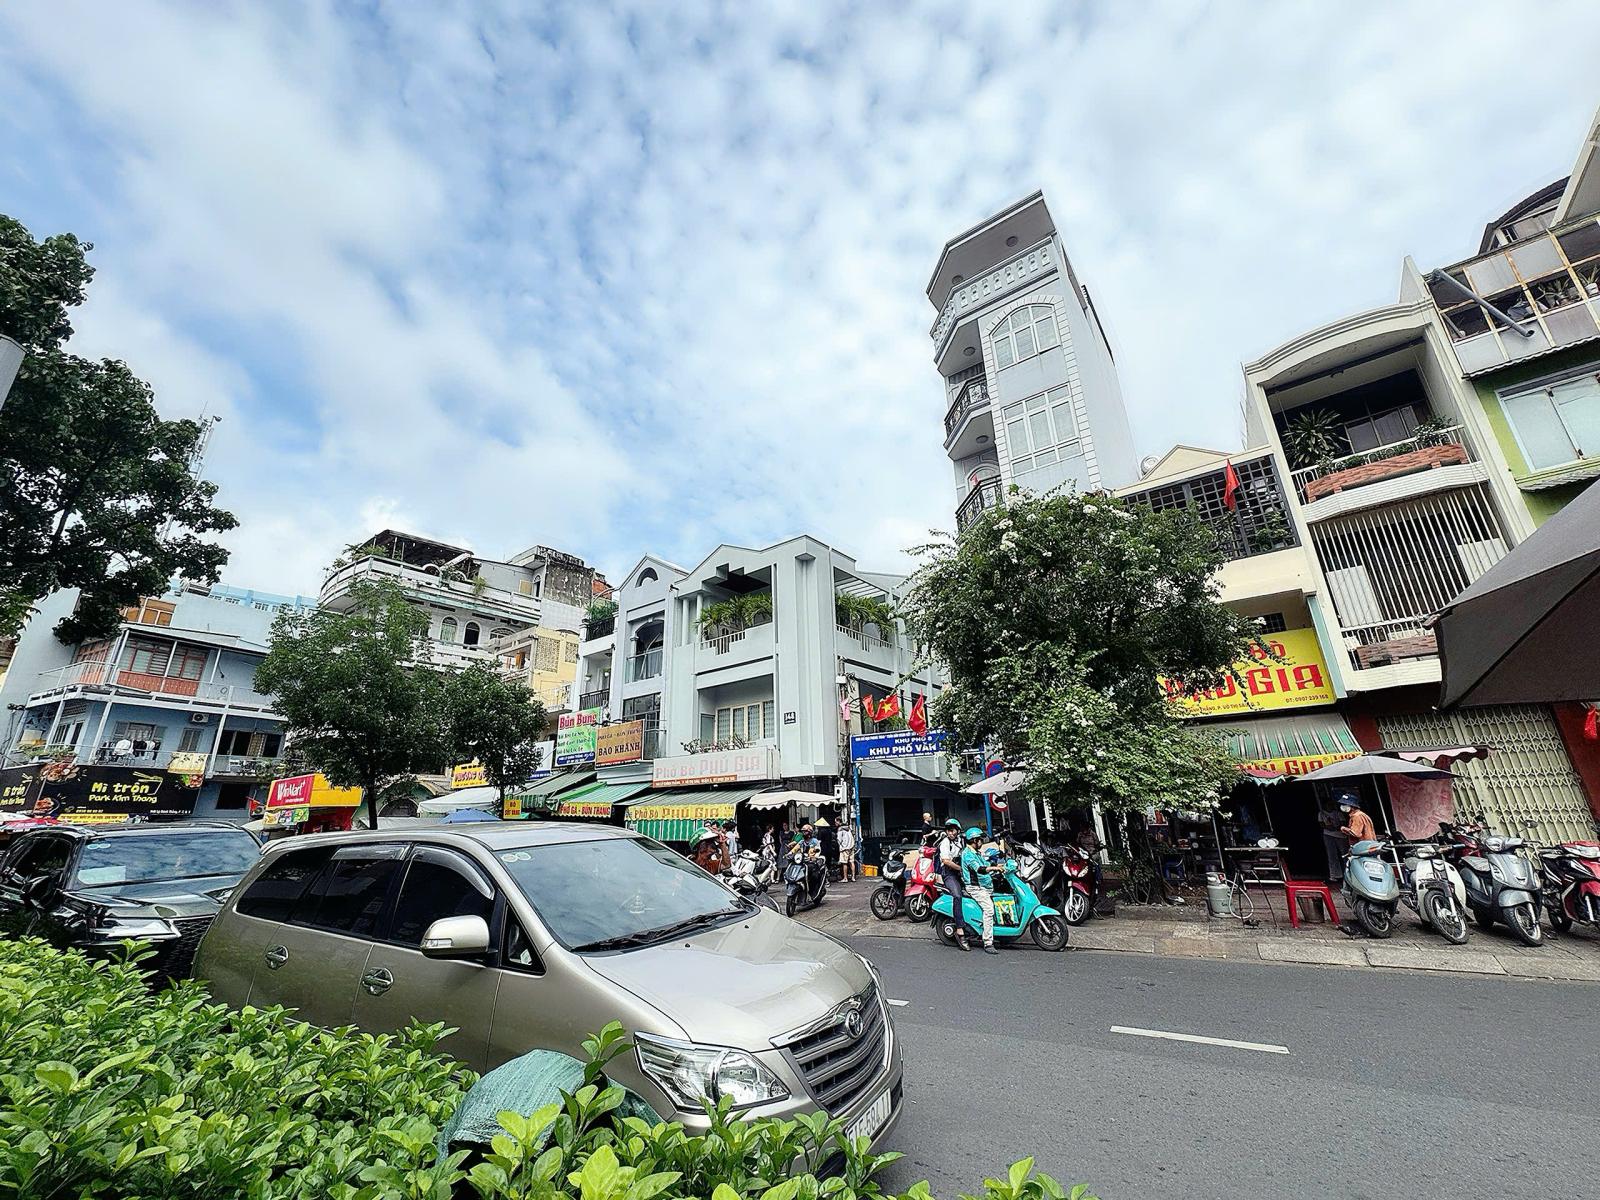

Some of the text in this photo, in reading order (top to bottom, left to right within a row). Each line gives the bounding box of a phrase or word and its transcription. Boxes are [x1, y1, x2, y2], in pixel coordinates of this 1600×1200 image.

[1246, 664, 1324, 696] GIA
[869, 747, 890, 756] KHU
[892, 742, 912, 754] PHỐ
[914, 742, 936, 752] VĂN
[734, 756, 760, 772] GIA
[1284, 759, 1324, 775] GIA
[112, 782, 150, 796] trộn
[88, 794, 111, 802] Park
[112, 794, 130, 802] Kim
